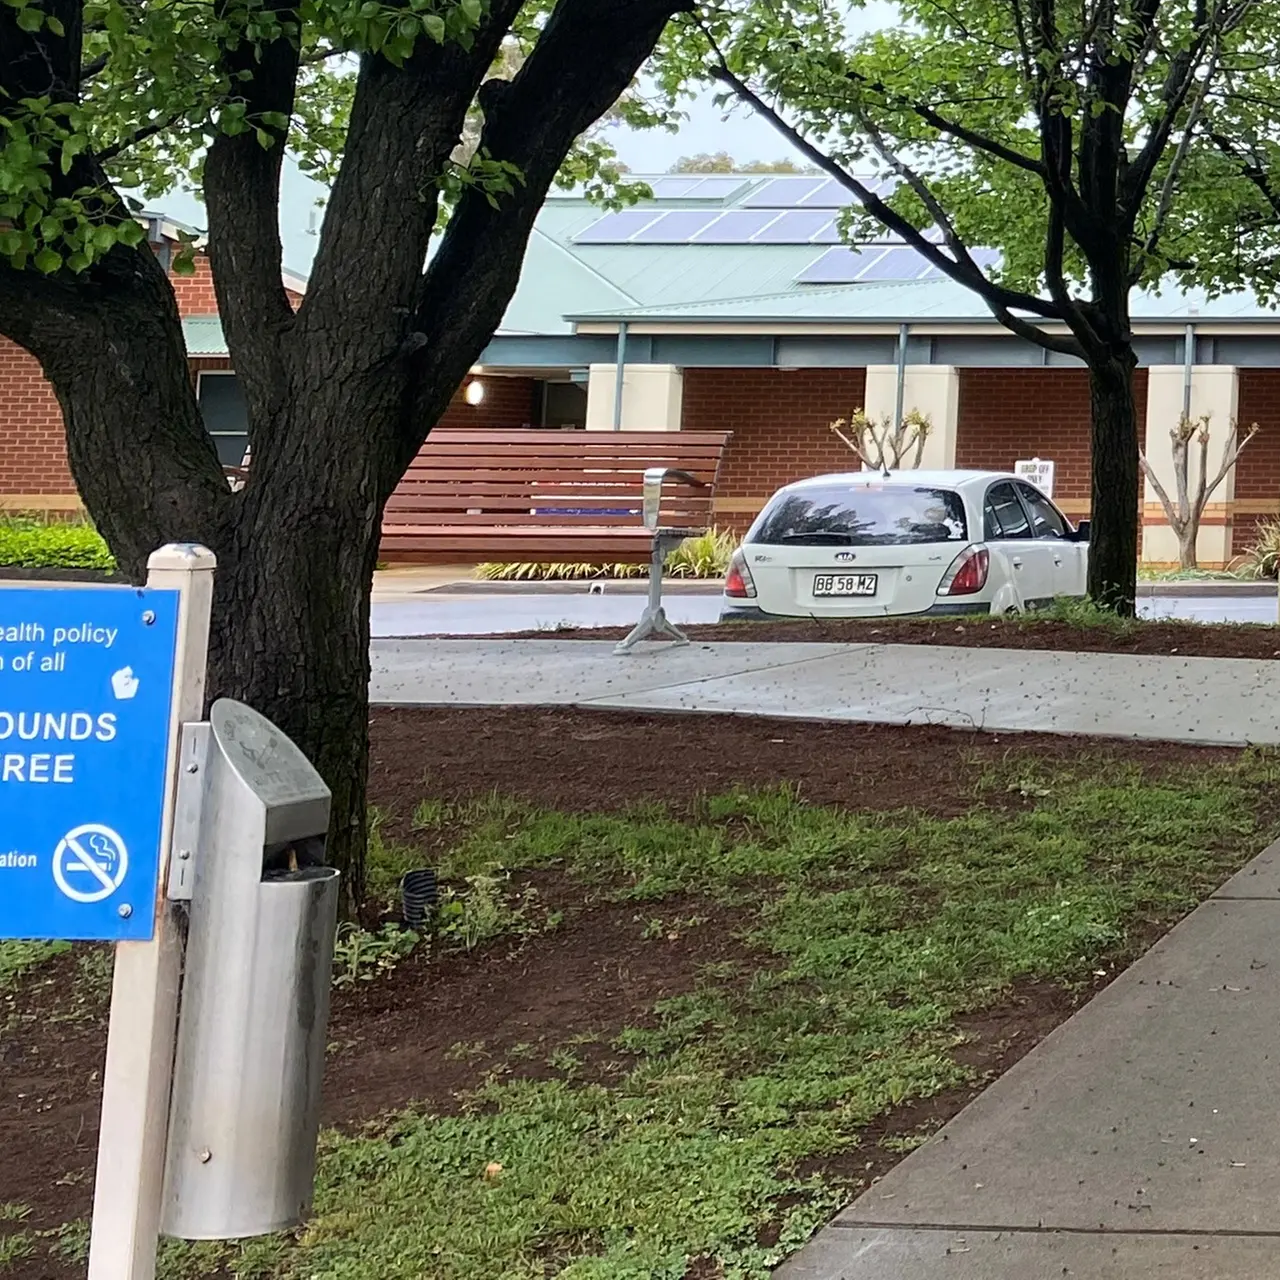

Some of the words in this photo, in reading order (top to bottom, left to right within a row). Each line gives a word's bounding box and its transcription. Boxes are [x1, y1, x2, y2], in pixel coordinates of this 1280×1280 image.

[837, 577, 854, 591] 58
[52, 622, 118, 648] policy
[12, 651, 34, 671] of
[40, 651, 65, 671] all
[0, 753, 75, 783] REE
